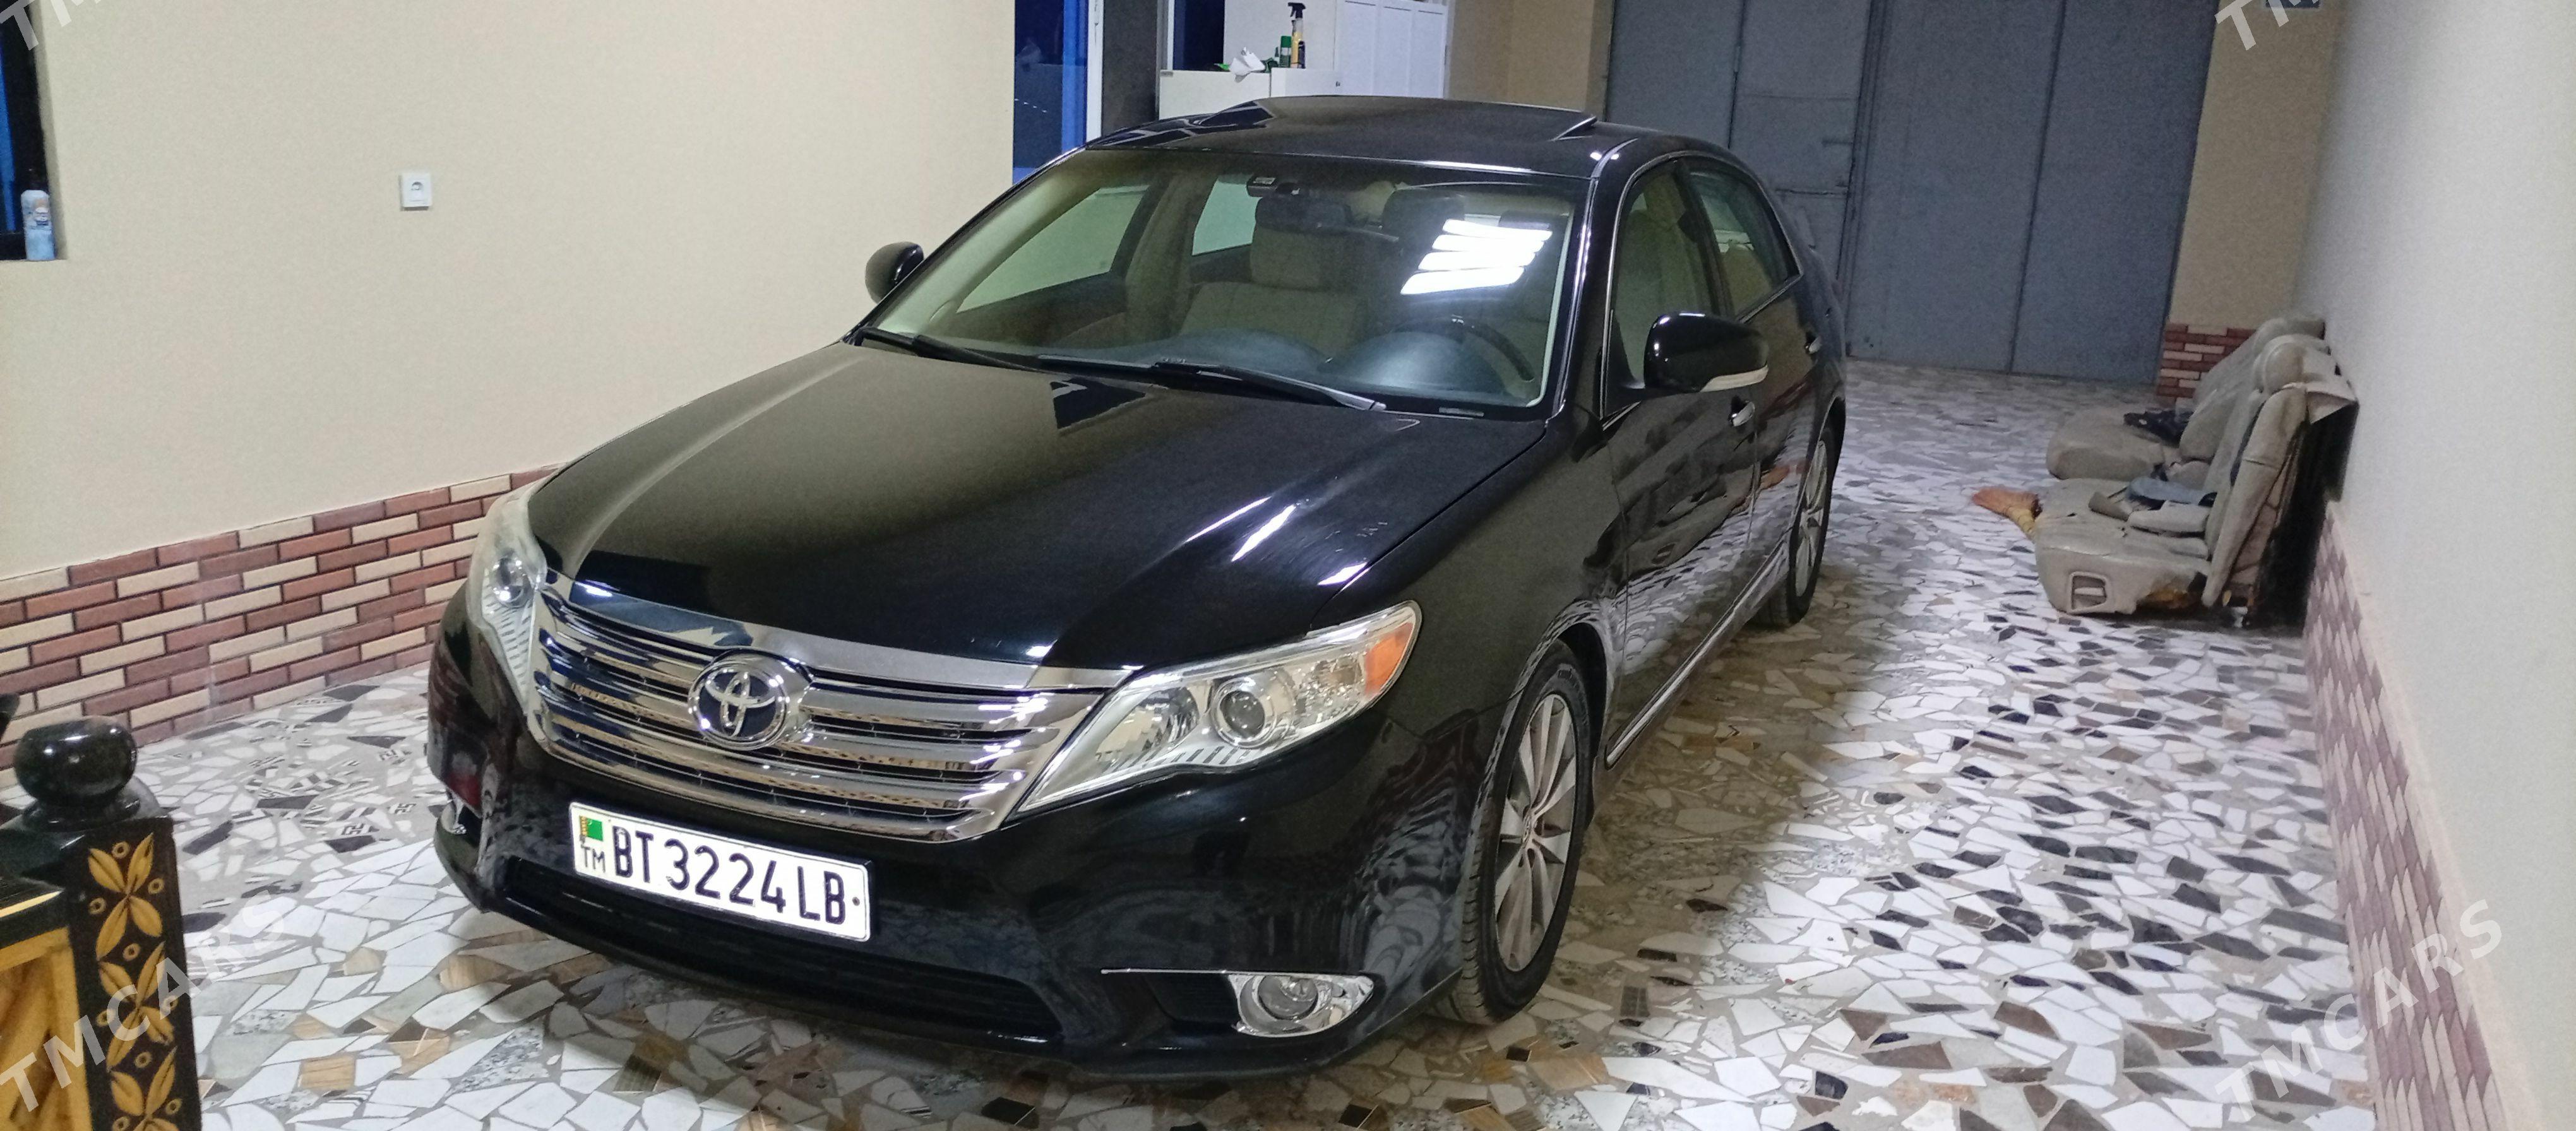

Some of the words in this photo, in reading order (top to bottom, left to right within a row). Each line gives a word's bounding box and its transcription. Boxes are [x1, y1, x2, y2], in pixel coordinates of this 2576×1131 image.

[581, 844, 605, 873] TM
[611, 826, 654, 883] BT
[664, 838, 787, 913] 3224
[797, 865, 846, 925] LB
